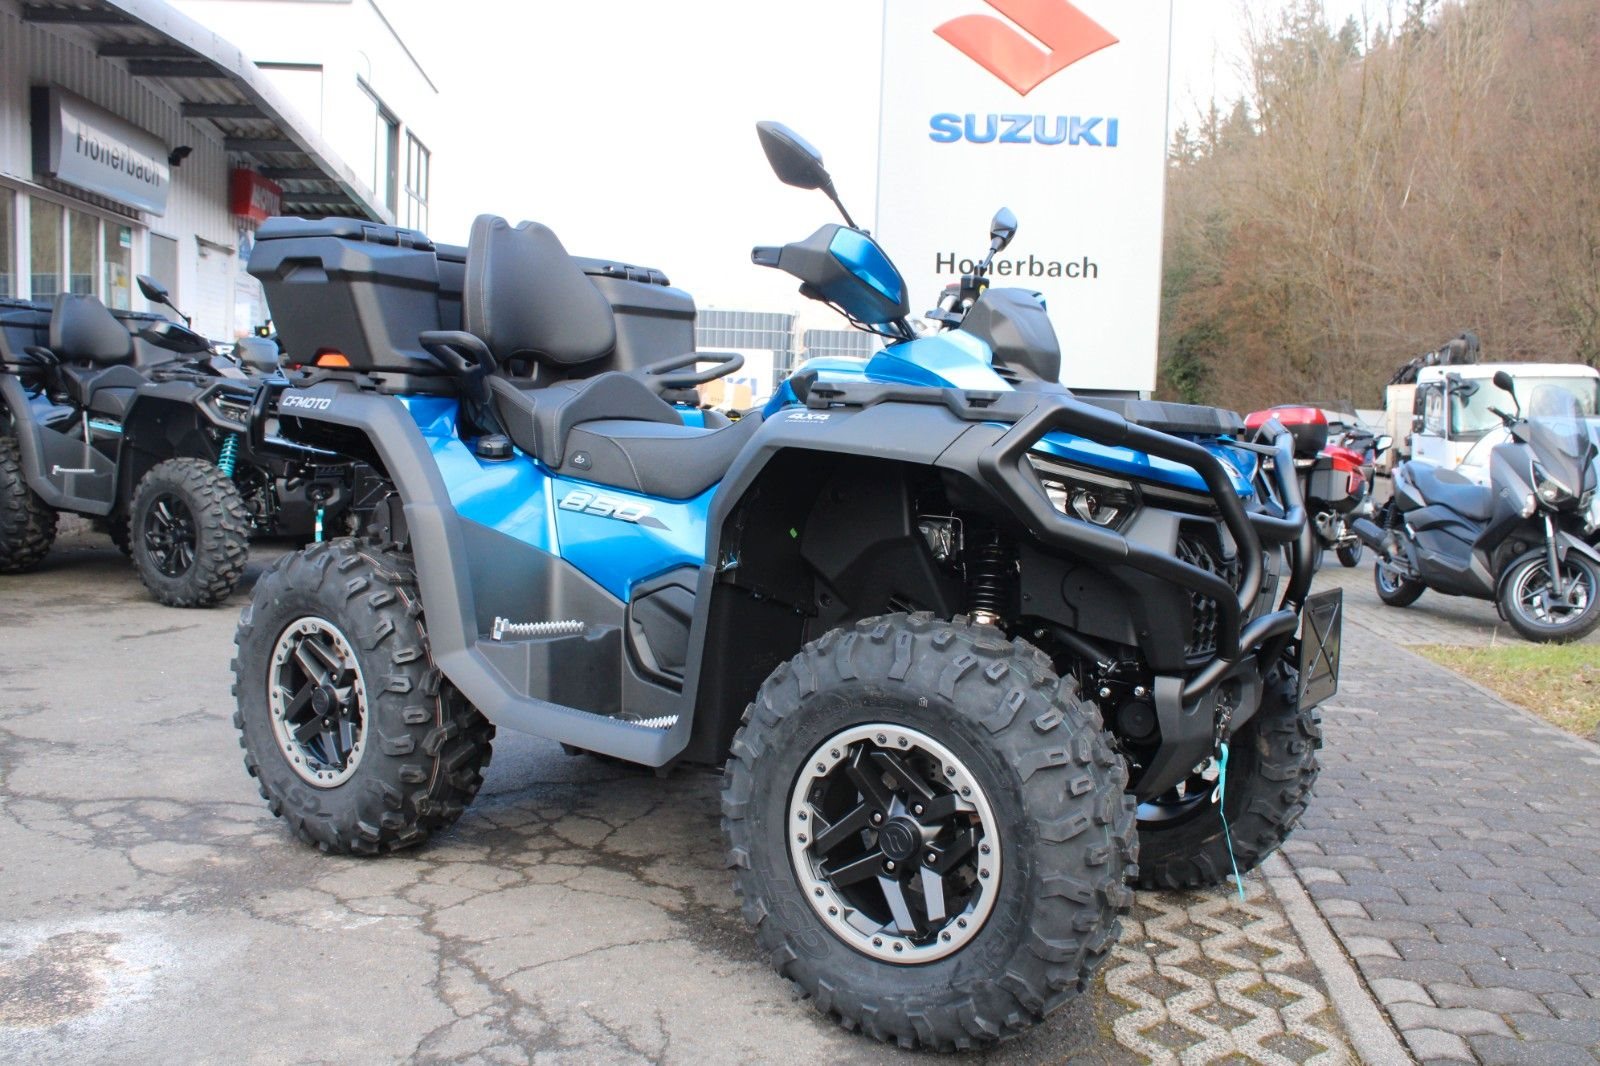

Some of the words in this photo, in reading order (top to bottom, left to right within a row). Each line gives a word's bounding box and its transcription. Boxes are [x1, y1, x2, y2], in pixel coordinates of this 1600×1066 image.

[928, 112, 1119, 148] SUZUKI
[76, 121, 160, 187] Honerbach
[281, 395, 332, 410] CFMOTO
[558, 489, 655, 523] 850
